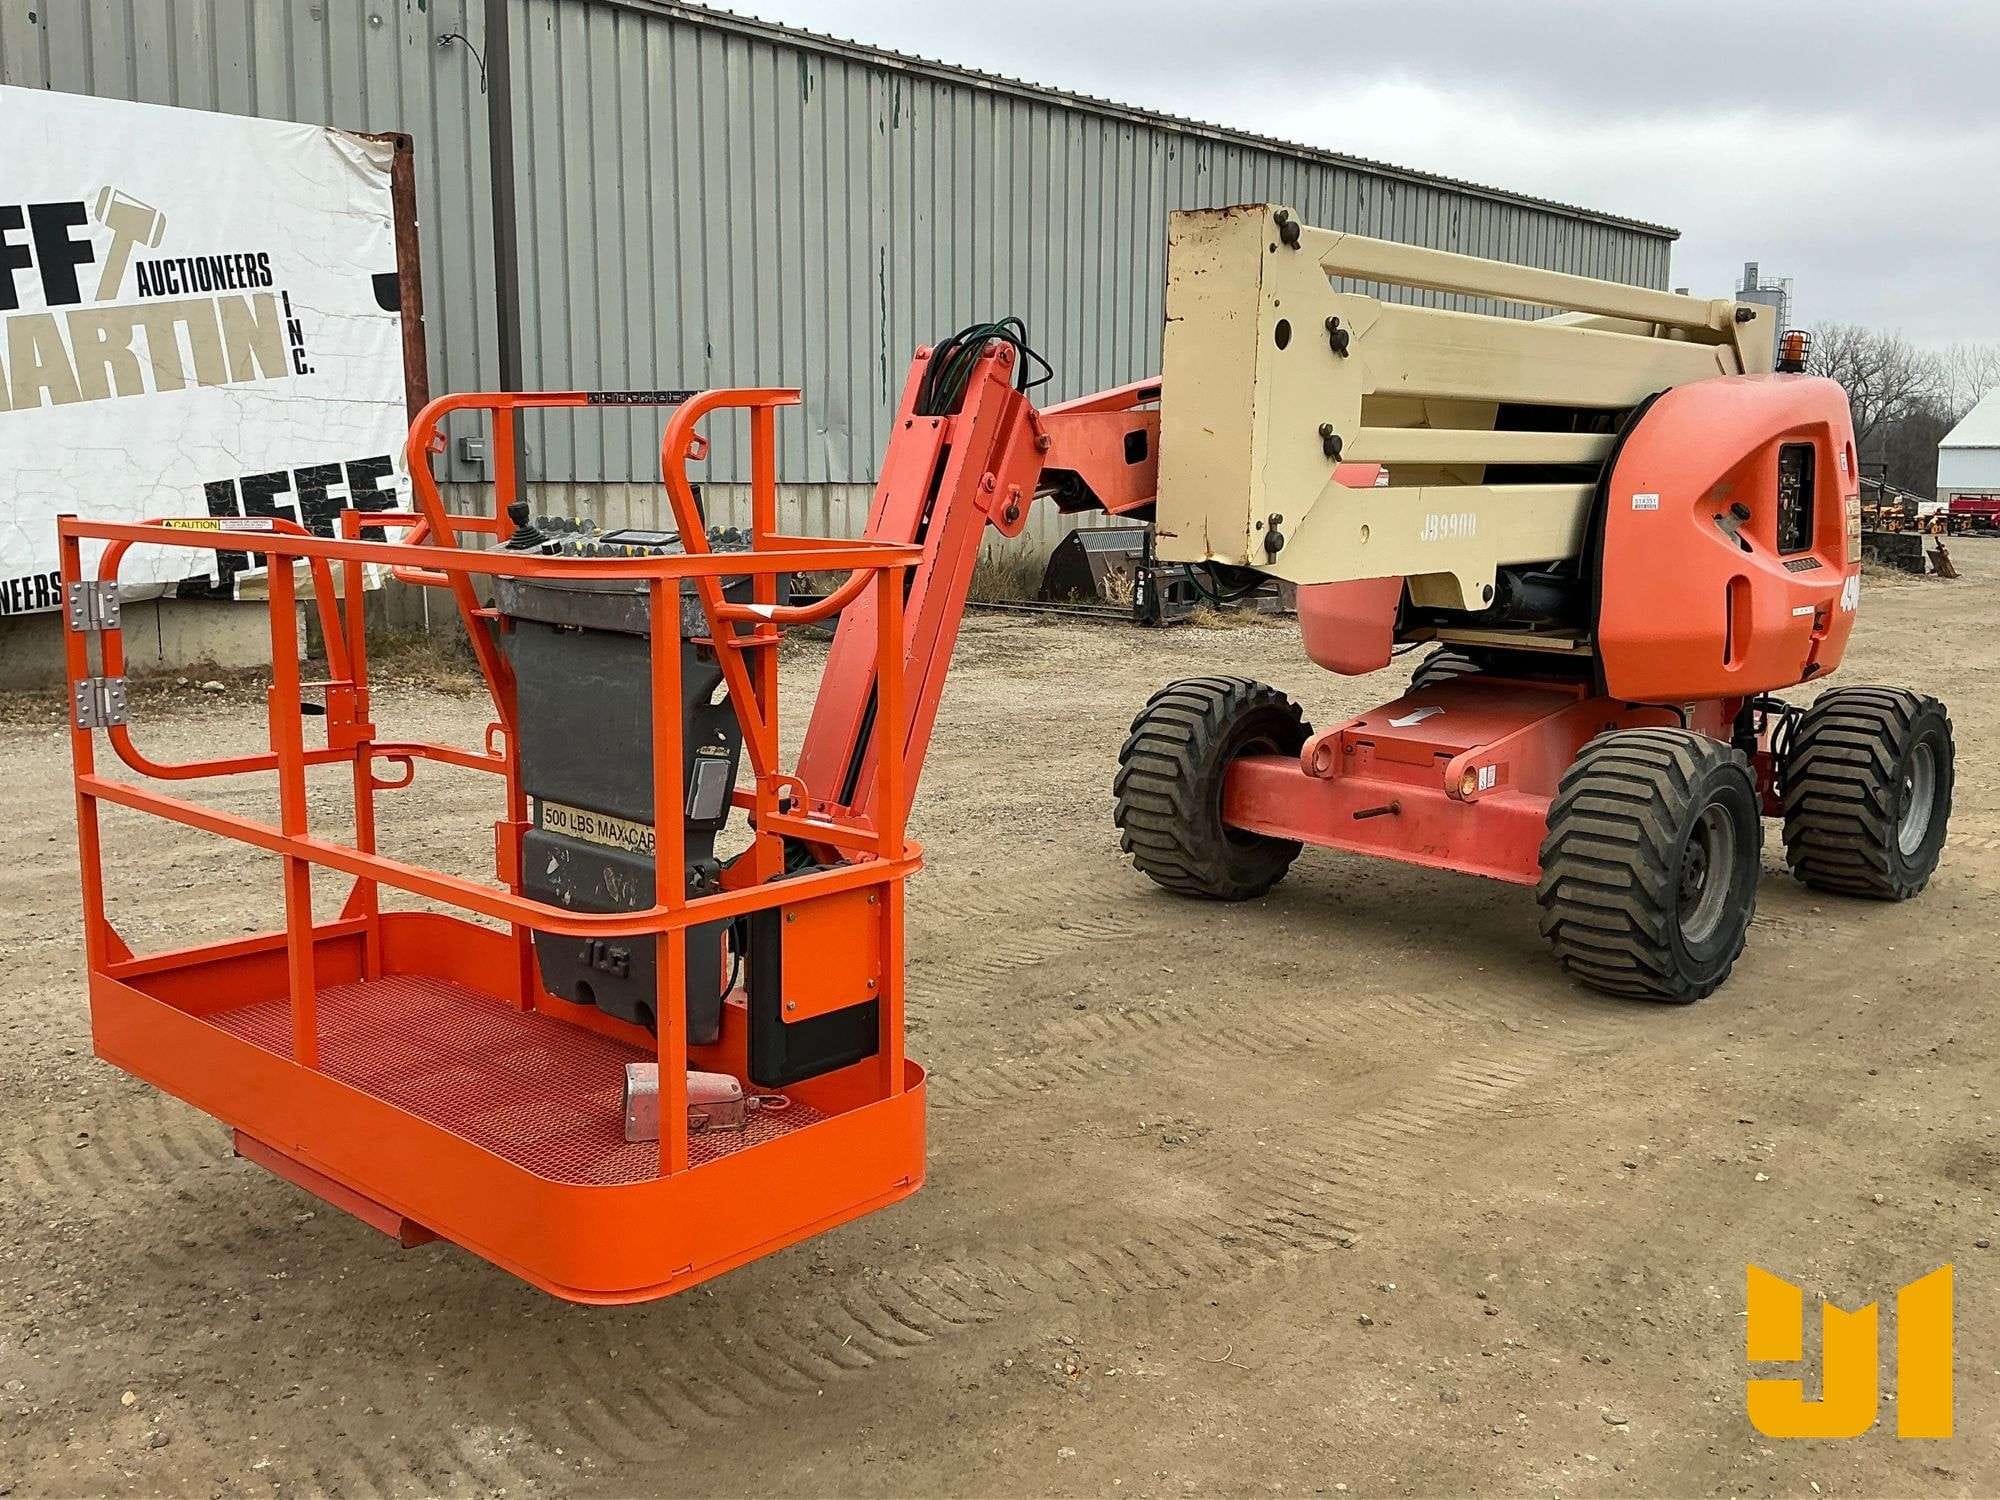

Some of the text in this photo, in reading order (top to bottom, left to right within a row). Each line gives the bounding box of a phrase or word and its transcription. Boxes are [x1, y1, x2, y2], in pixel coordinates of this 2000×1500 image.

[135, 252, 273, 298] AUCTIONEERS
[0, 291, 289, 412] ARTIN
[281, 290, 315, 375] INC.
[173, 520, 217, 529] CAUTION
[176, 455, 399, 600] JEFF
[545, 808, 567, 828] 500
[570, 813, 594, 834] LBS
[598, 820, 625, 842] MAX
